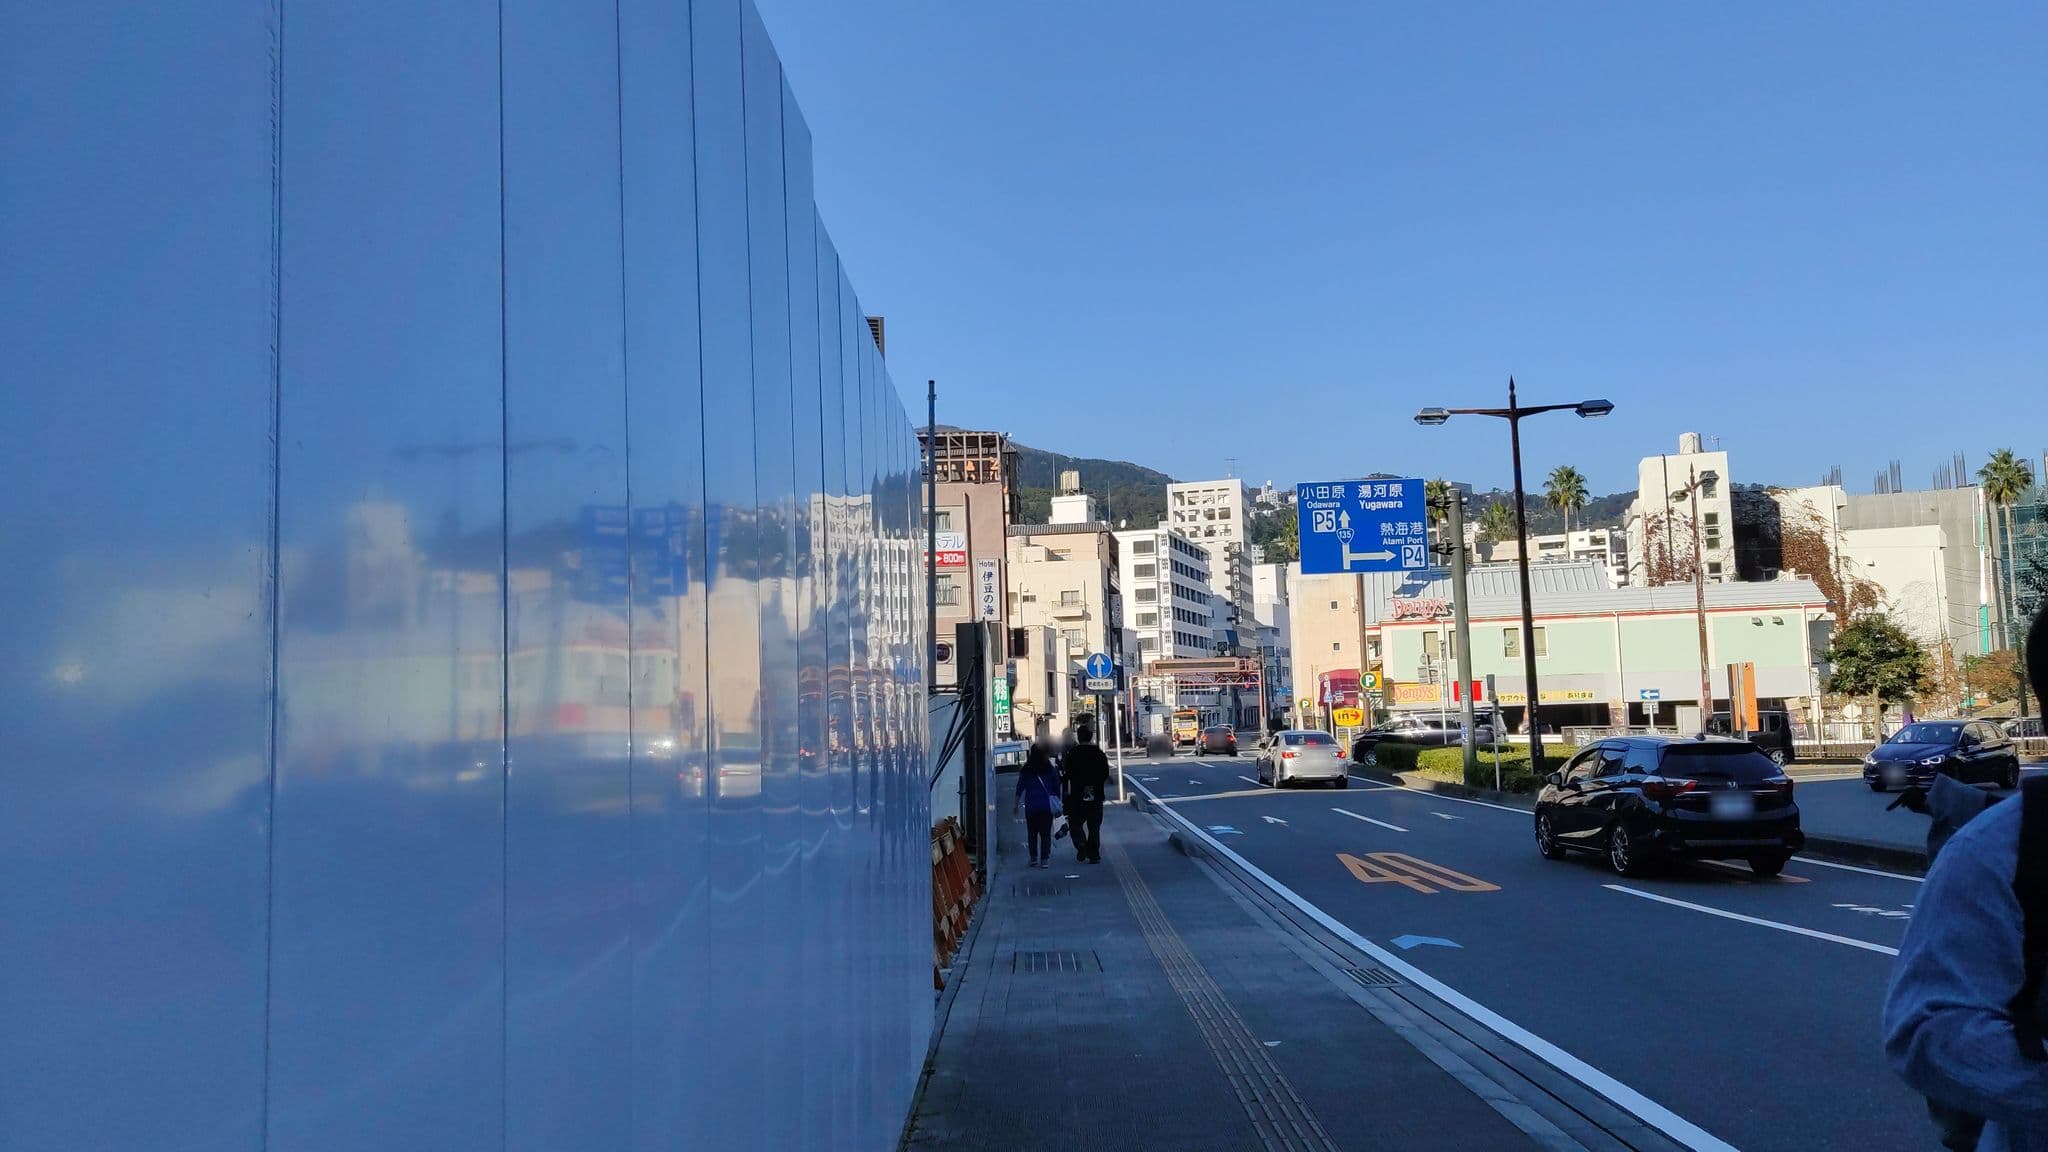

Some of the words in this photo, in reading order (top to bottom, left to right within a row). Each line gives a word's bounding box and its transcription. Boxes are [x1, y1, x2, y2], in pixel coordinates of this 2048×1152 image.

[1301, 485, 1346, 500] 小田原
[1357, 483, 1404, 499] 湯河原
[1306, 500, 1341, 509] Odawara
[1359, 500, 1404, 511] Yugawara
[1314, 511, 1335, 532] P5
[1379, 521, 1425, 536] 熱海港
[1338, 530, 1352, 539] 135
[1382, 537, 1405, 546] Atami
[1406, 536, 1424, 545] Port
[943, 553, 965, 564] 800m
[978, 560, 996, 568] Hotel
[1403, 546, 1424, 567] P4
[982, 571, 995, 616] 伊豆の海
[1336, 852, 1503, 894] 40
